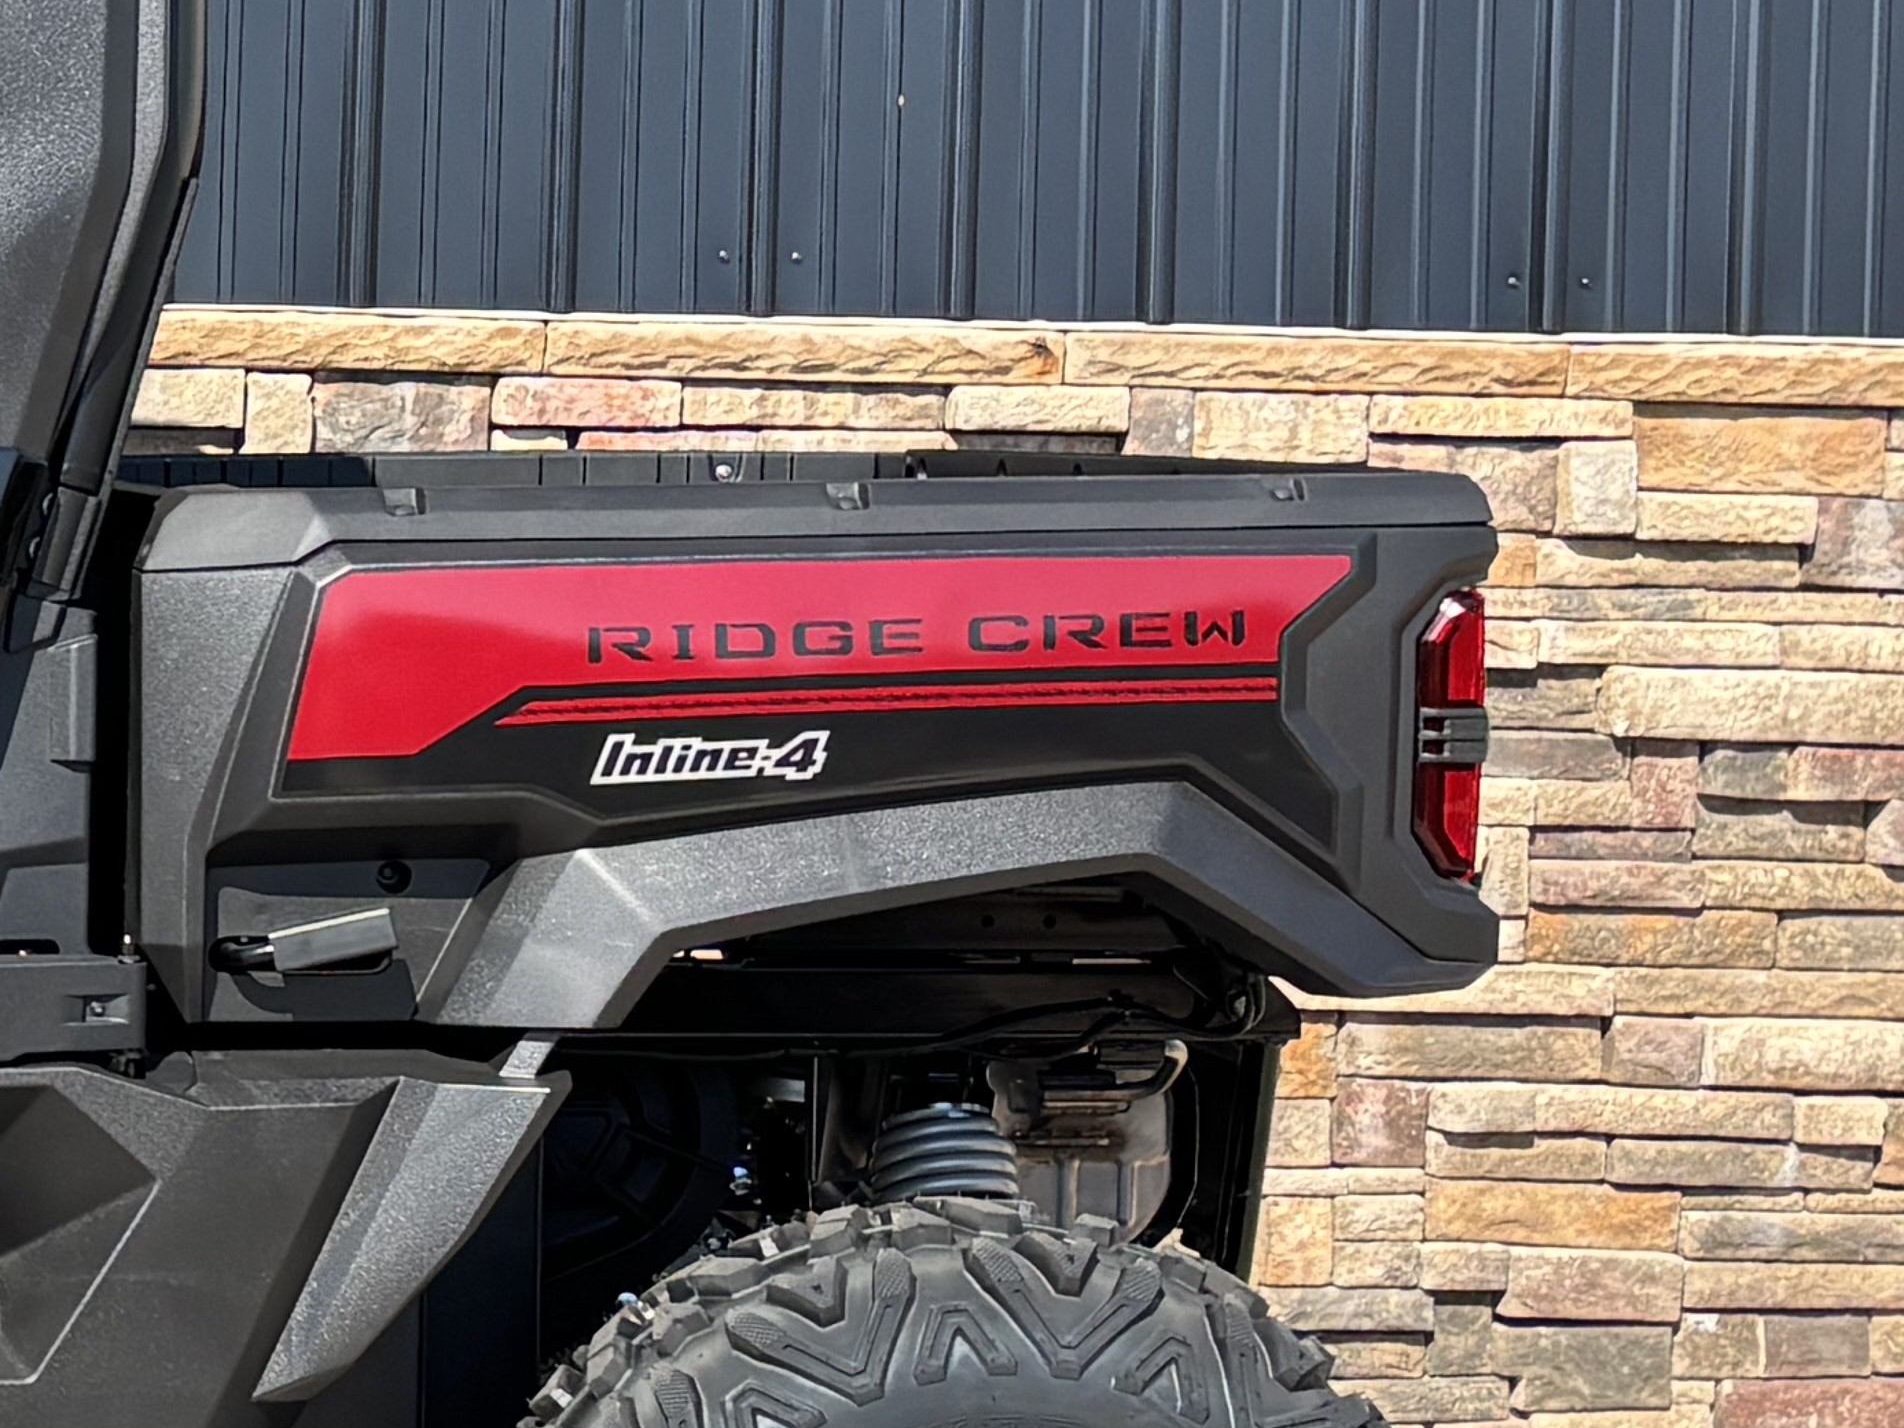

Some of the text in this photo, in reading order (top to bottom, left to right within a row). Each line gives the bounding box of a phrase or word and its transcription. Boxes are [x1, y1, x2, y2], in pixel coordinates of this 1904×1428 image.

[587, 608, 1247, 664] RIDGE CREW
[590, 729, 830, 786] Inline-4
